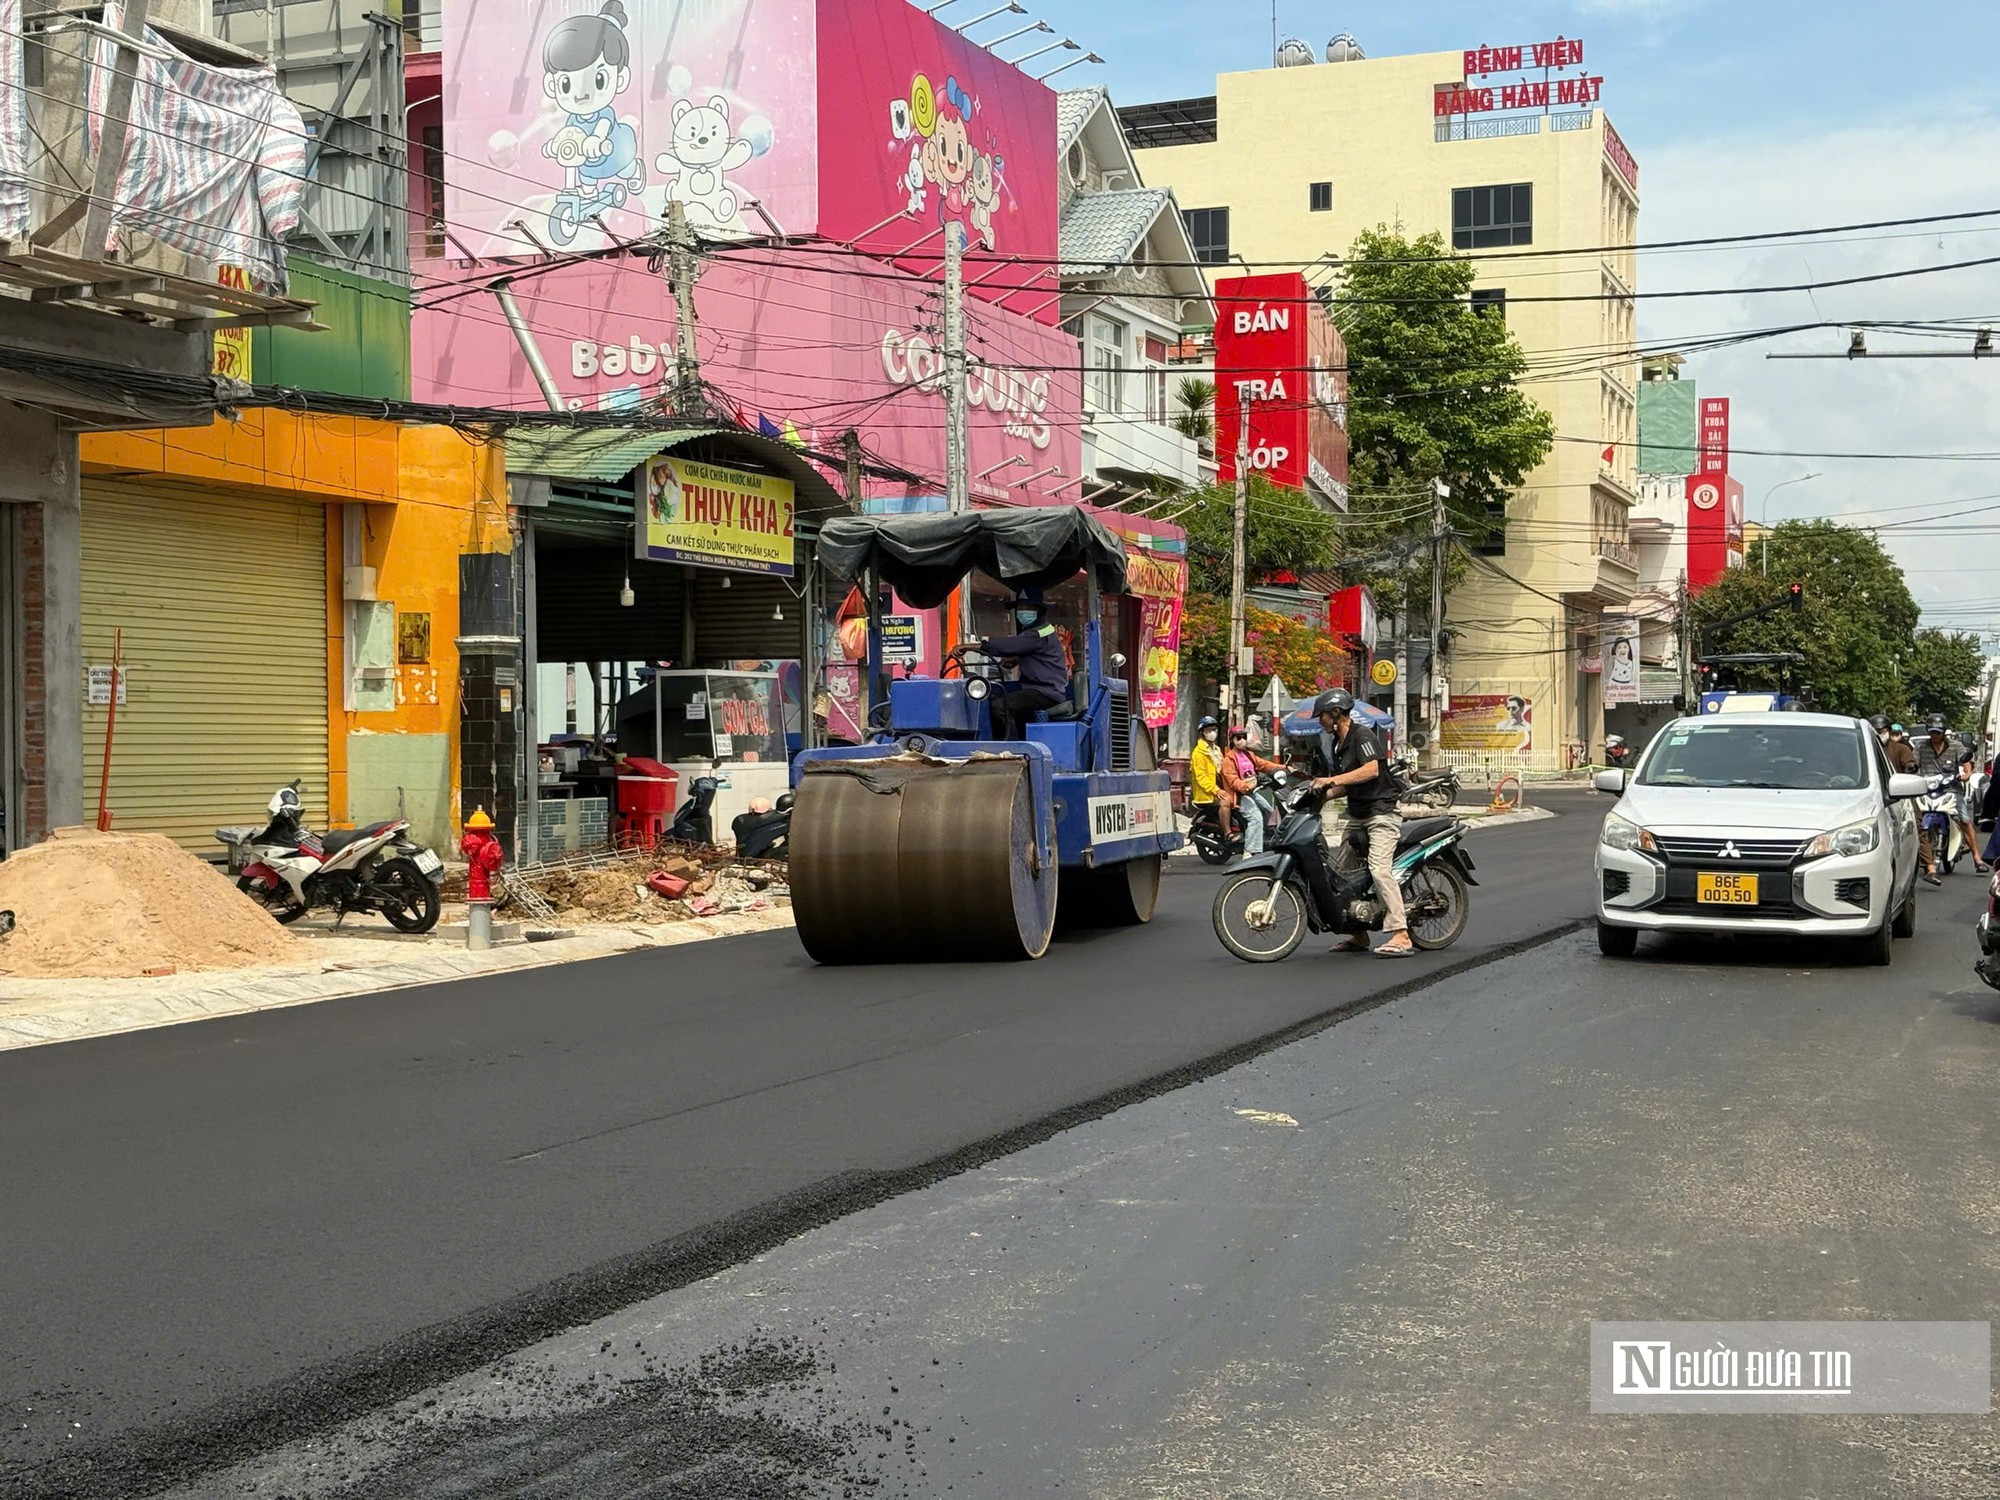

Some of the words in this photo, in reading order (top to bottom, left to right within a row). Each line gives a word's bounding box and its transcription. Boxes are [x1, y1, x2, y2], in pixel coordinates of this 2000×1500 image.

[1464, 43, 1522, 79] BỆNH
[1531, 35, 1583, 71] VIỆN
[1434, 82, 1494, 116] RĂNG
[1501, 77, 1550, 110] HÀM
[1557, 71, 1604, 108] MẶT
[1234, 302, 1290, 334] BÁN
[1704, 416, 1725, 427] KHOA
[1707, 430, 1722, 441] SÀI
[1235, 439, 1288, 470] ÓP
[1706, 460, 1722, 470] KIM
[740, 493, 779, 535] KHA
[783, 502, 795, 538] 2
[666, 534, 682, 545] CAM
[1096, 803, 1127, 835] HYSTER
[1714, 875, 1741, 889] 86E
[1704, 889, 1752, 902] 003.50
